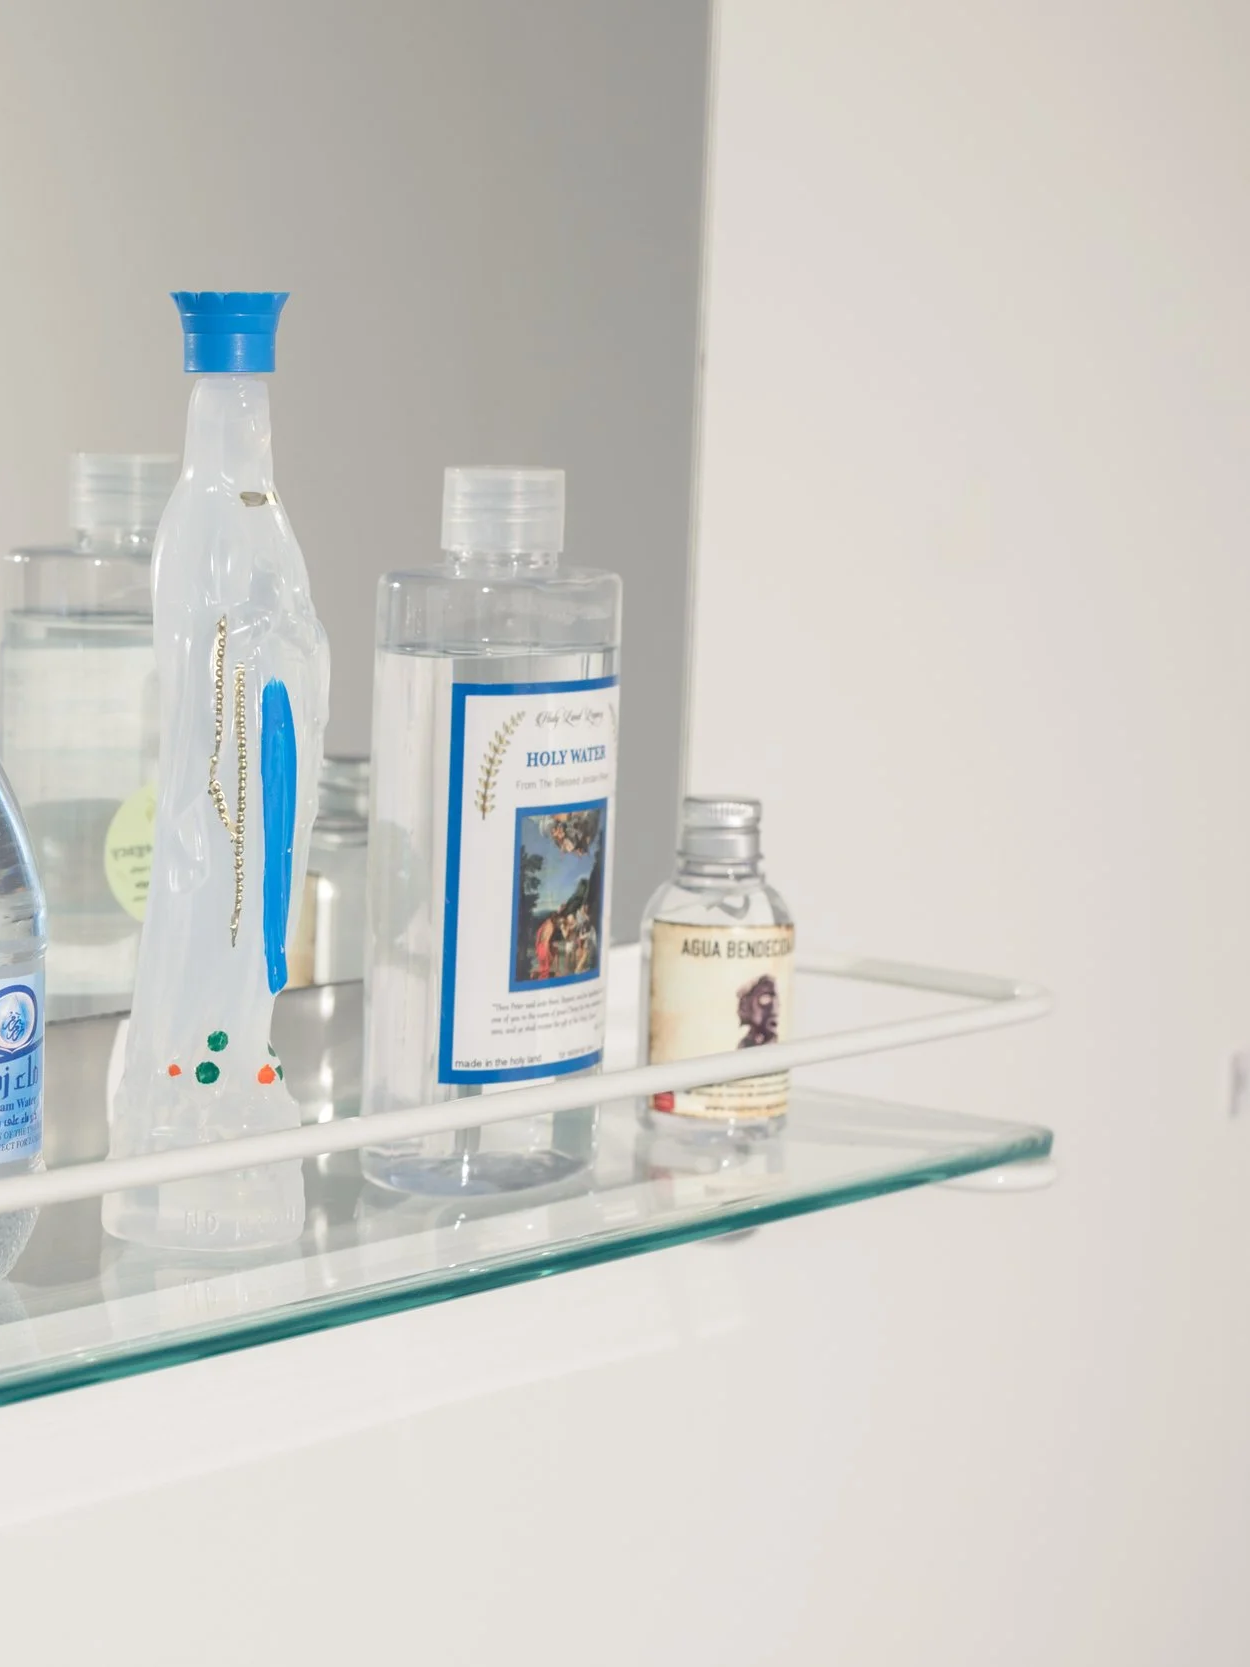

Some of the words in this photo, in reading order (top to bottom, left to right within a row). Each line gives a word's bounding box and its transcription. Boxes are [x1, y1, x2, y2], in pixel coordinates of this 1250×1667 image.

[526, 751, 568, 768] HOLY
[570, 745, 606, 764] WATER
[515, 779, 537, 791] From
[681, 938, 720, 958] AGUA
[454, 1057, 483, 1068] made
[485, 1057, 494, 1068] in
[494, 1055, 509, 1068] the
[509, 1055, 527, 1068] holy
[2, 1127, 13, 1139] OF
